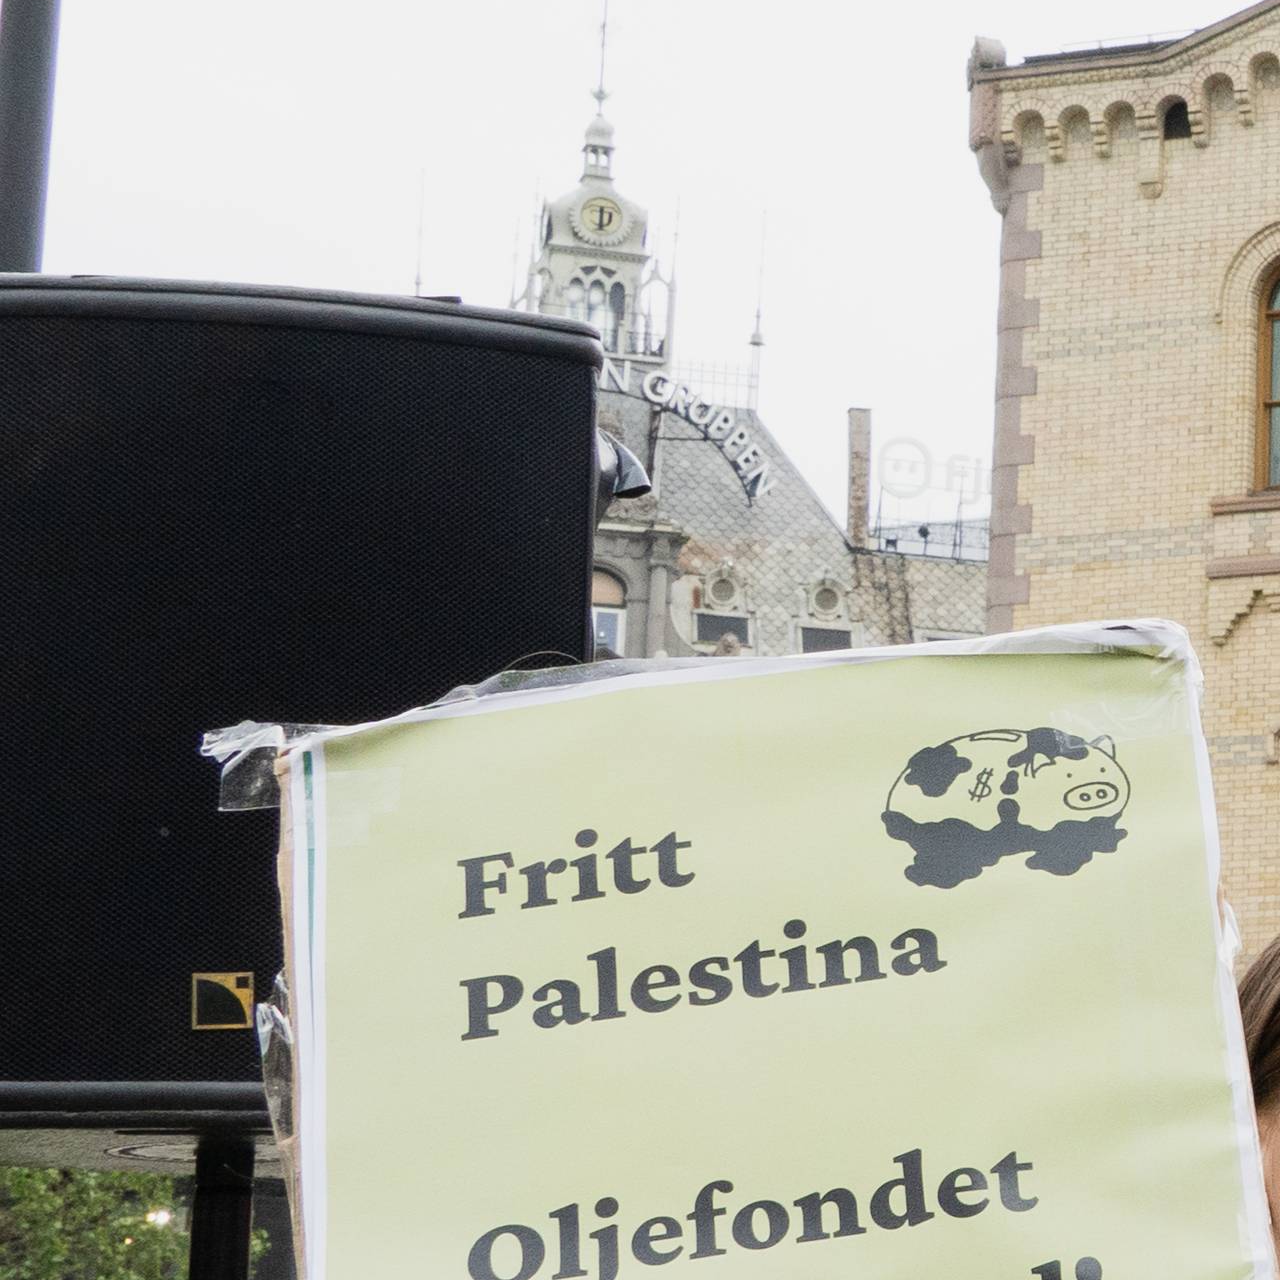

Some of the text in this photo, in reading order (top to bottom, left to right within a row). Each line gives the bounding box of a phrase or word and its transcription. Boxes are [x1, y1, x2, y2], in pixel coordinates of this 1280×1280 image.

[642, 371, 777, 497] GRUPPEN
[457, 829, 696, 919] Fritt
[459, 919, 948, 1041] Palestina
